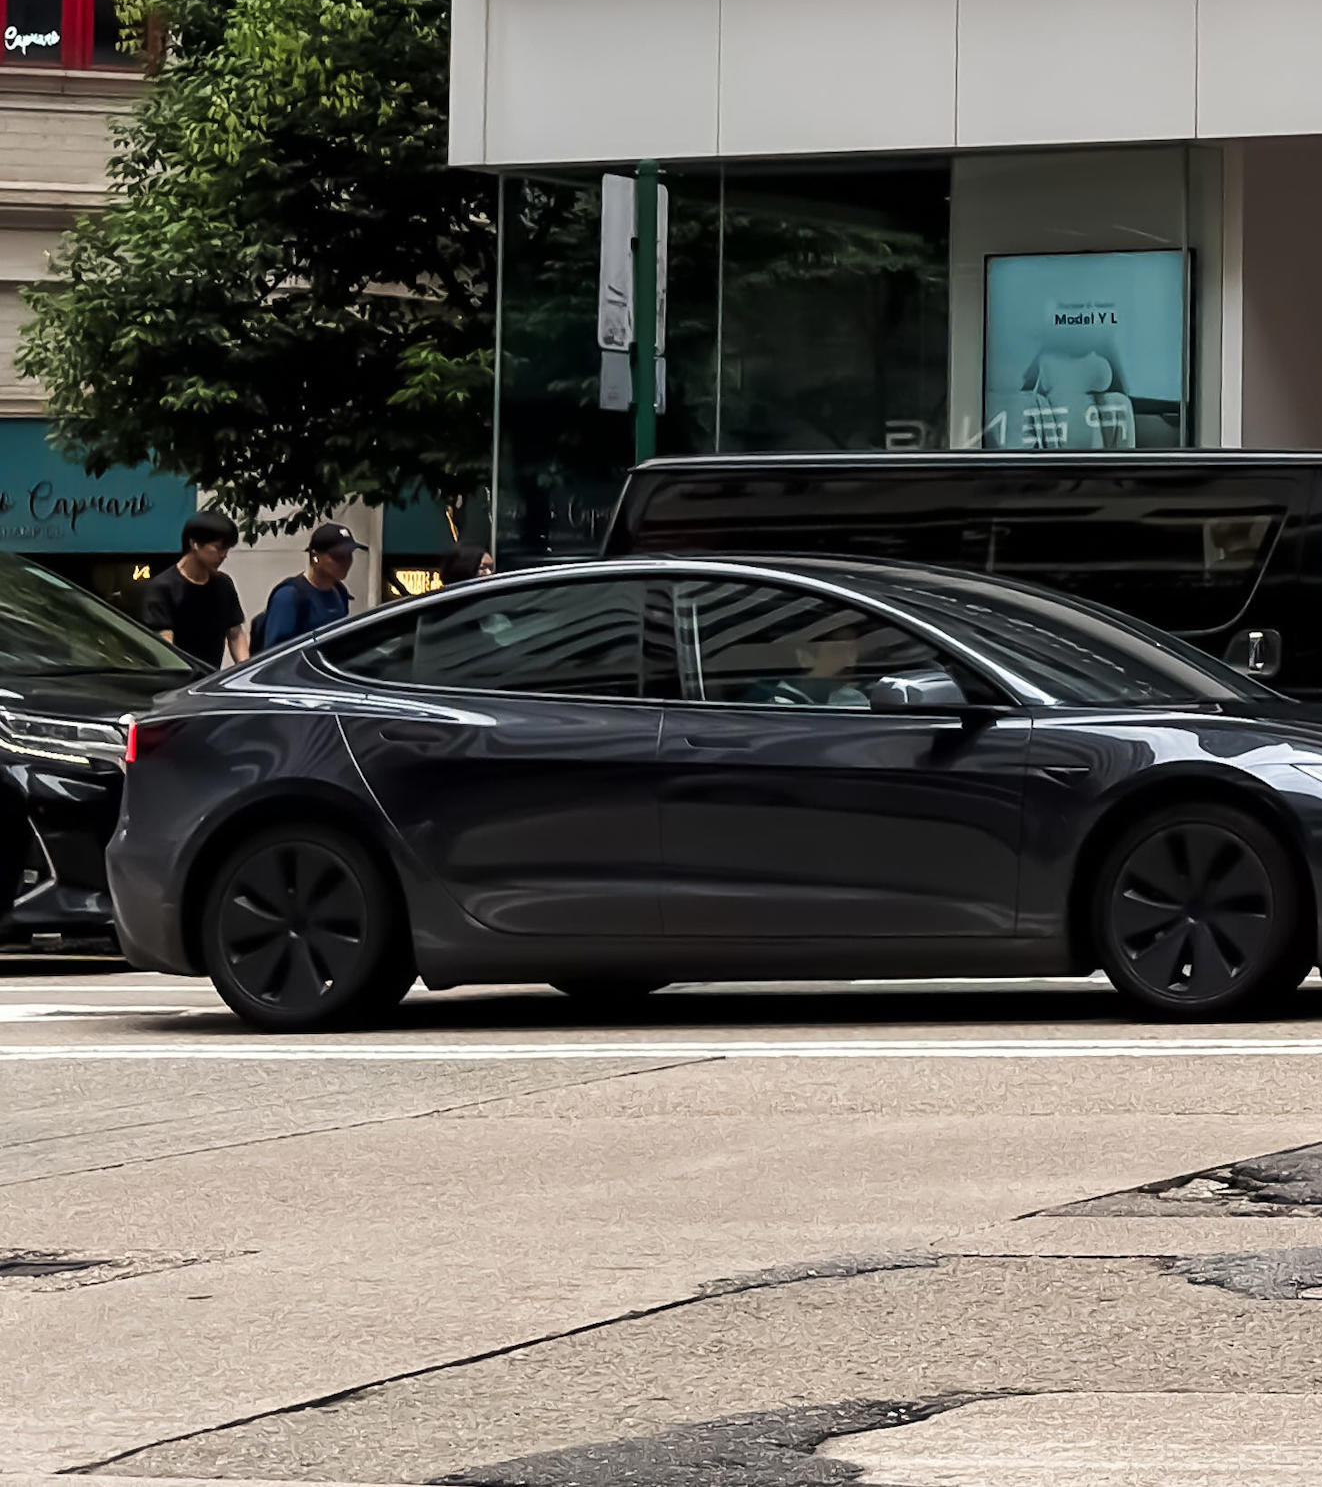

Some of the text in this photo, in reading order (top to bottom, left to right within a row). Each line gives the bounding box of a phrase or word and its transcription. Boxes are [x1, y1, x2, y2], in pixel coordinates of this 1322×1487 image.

[1054, 312, 1118, 326] Model Y L
